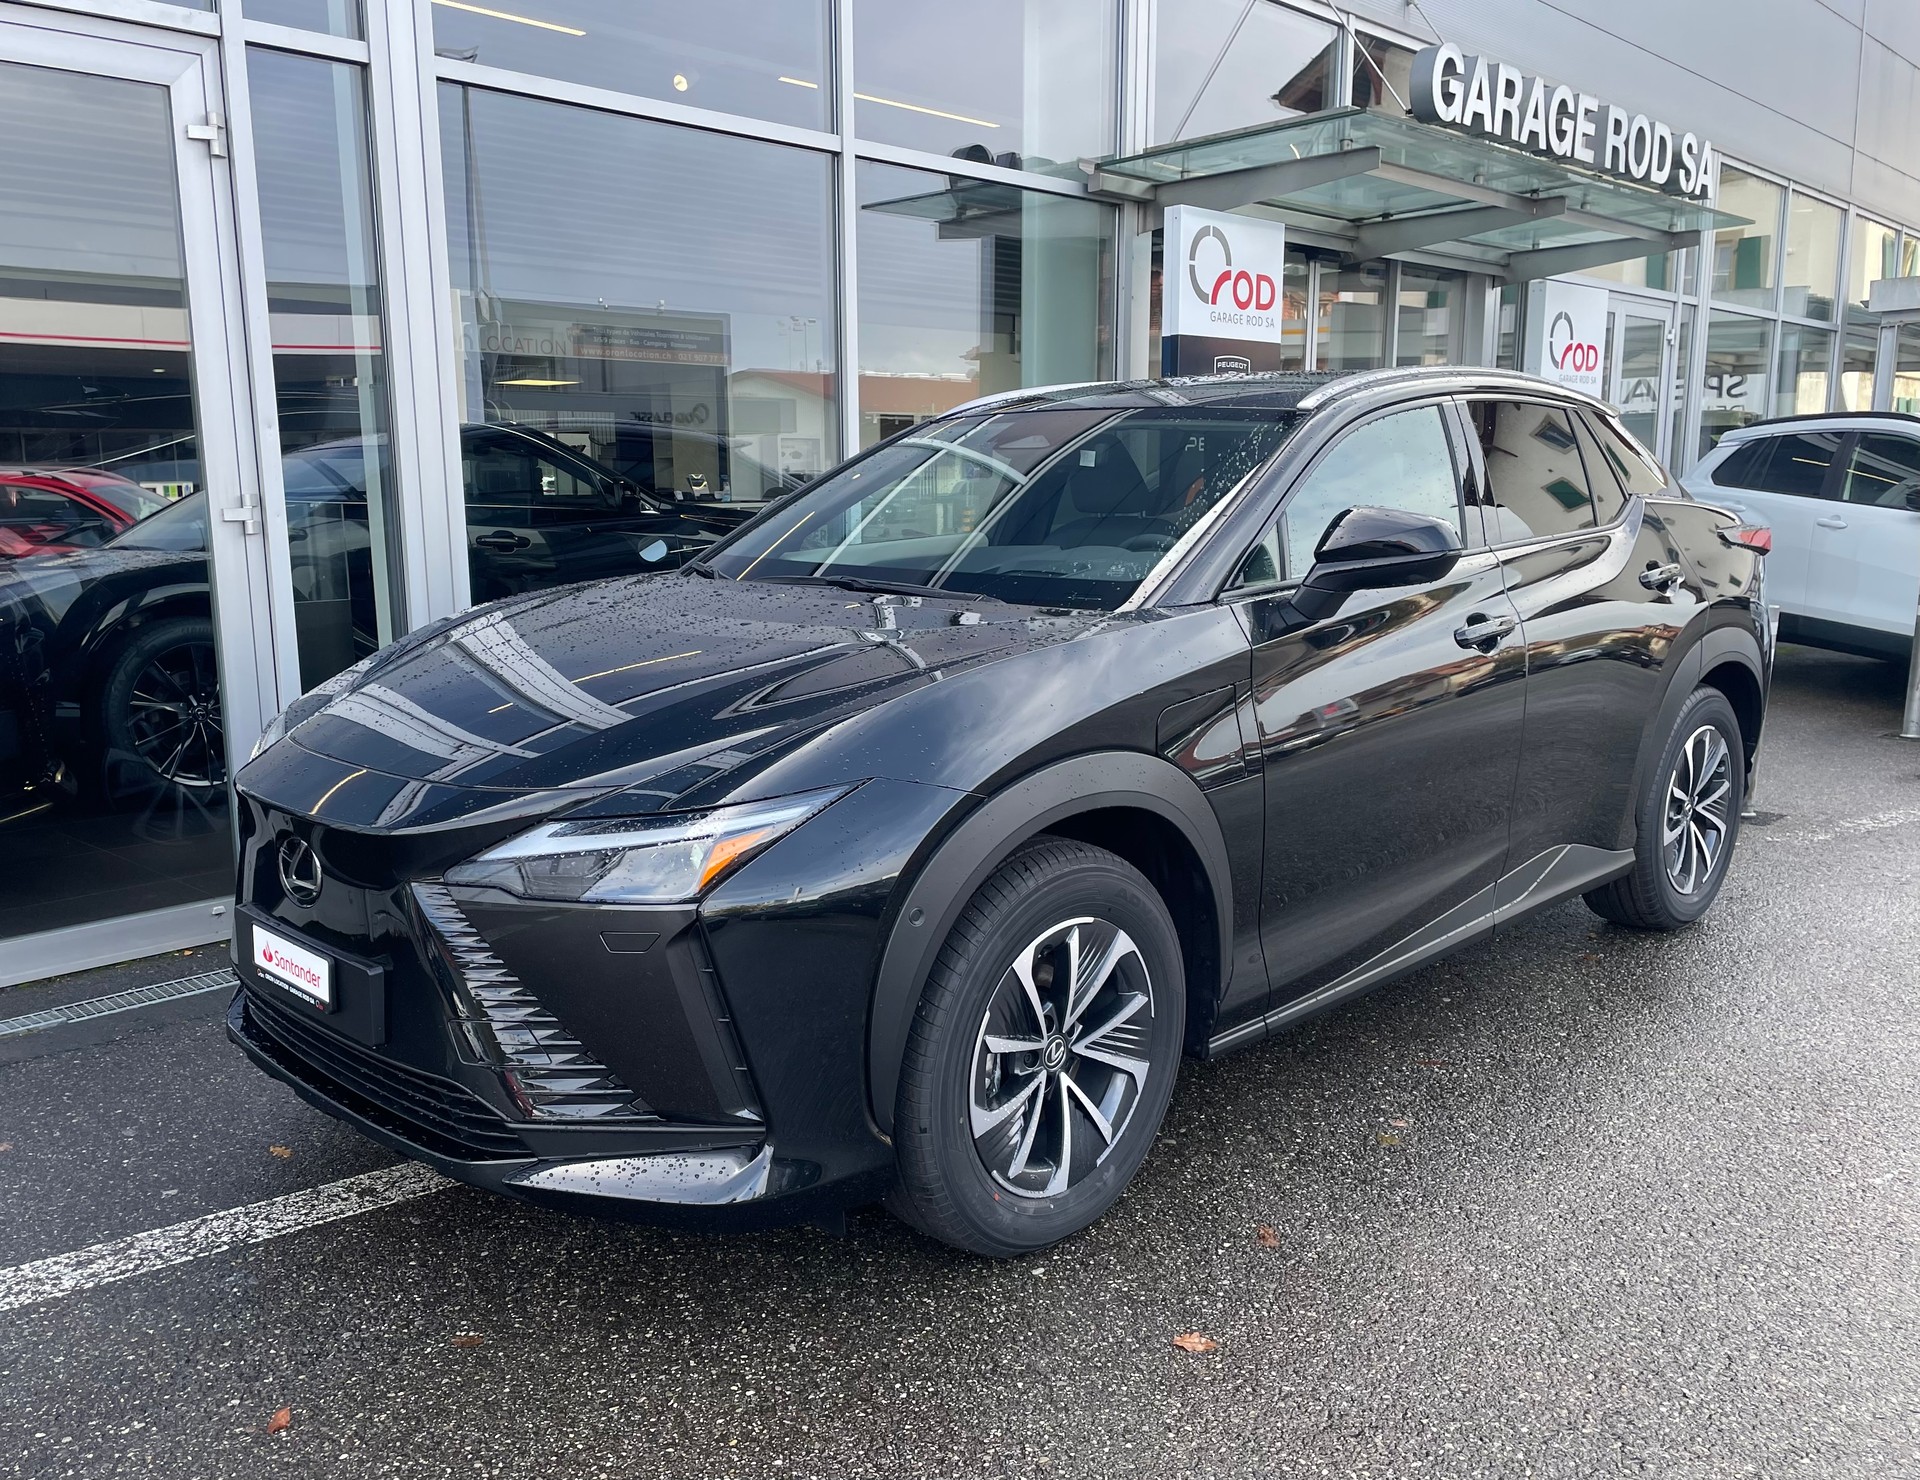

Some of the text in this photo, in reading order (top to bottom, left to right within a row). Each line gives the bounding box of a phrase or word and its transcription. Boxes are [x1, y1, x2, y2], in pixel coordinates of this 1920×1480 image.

[1431, 42, 1712, 196] GARAGE ROD SA
[1210, 311, 1275, 329] GARAGE ROD SA
[1217, 360, 1248, 370] PEUGEOT
[1559, 374, 1578, 384] GARAGE
[1579, 375, 1590, 384] ROD
[274, 950, 321, 988] Santander
